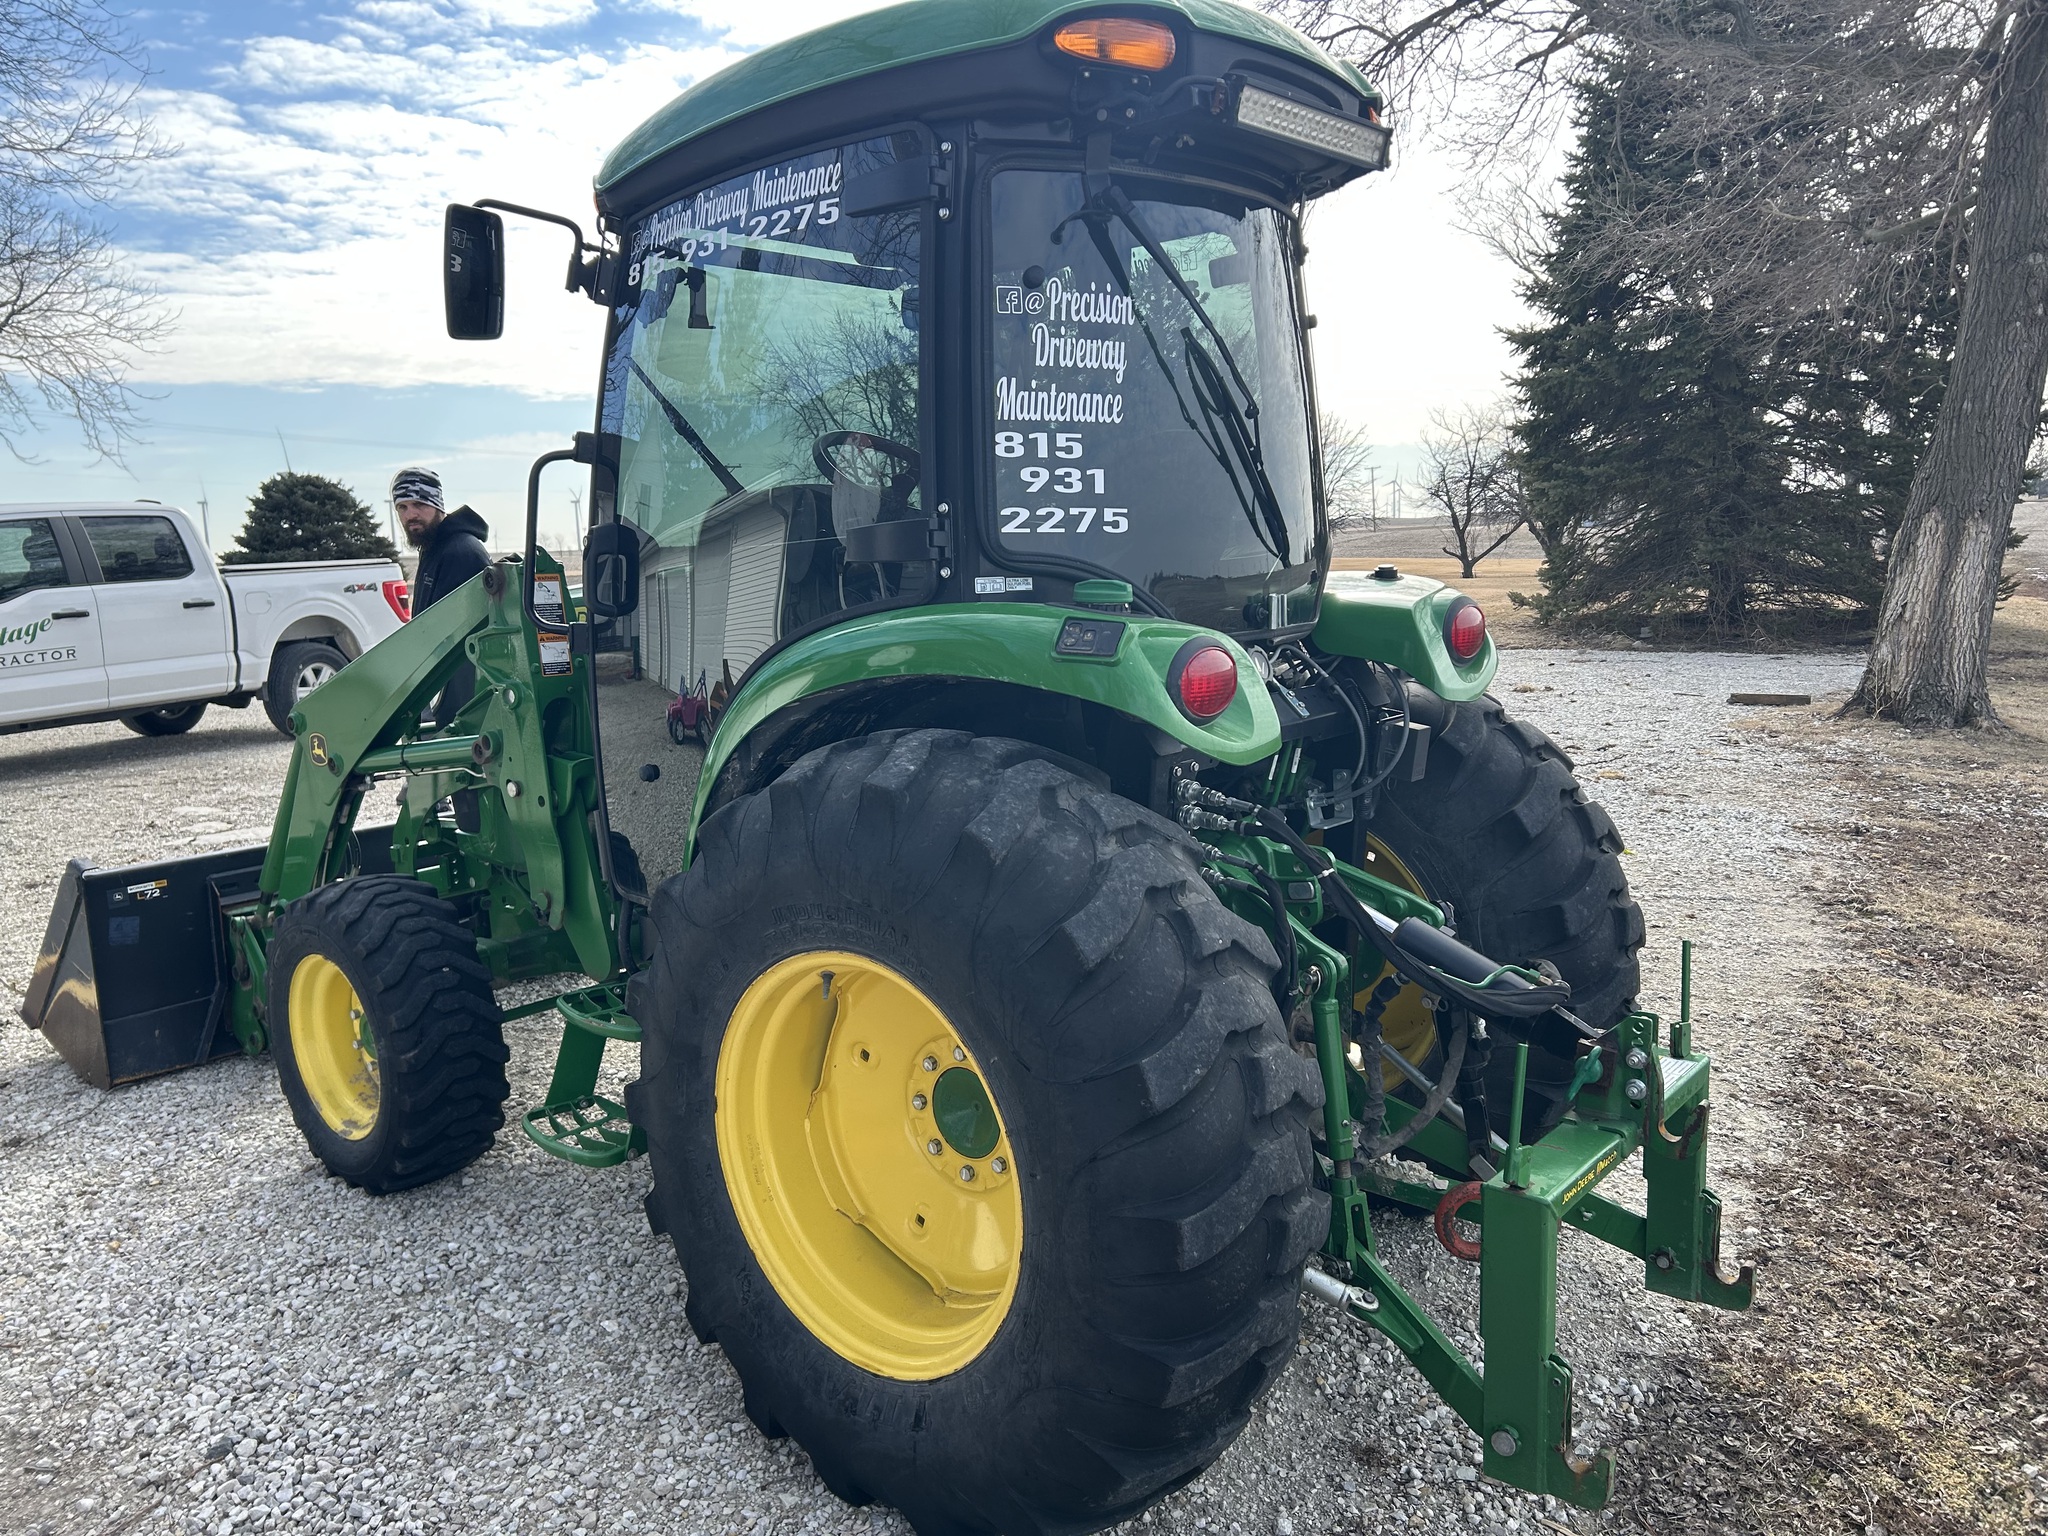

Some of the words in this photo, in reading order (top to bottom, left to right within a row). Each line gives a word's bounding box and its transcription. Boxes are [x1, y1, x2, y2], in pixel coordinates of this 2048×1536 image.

[695, 187, 749, 230] Driveway
[752, 162, 841, 211] Maintenance
[1032, 322, 1127, 384] Driveway
[996, 376, 1124, 424] Maintenance
[994, 431, 1083, 459] 815
[1020, 466, 1105, 494] 931
[1000, 507, 1129, 534] 2275
[1562, 1186, 1578, 1205] JOHN
[1577, 1170, 1595, 1191] DEERE
